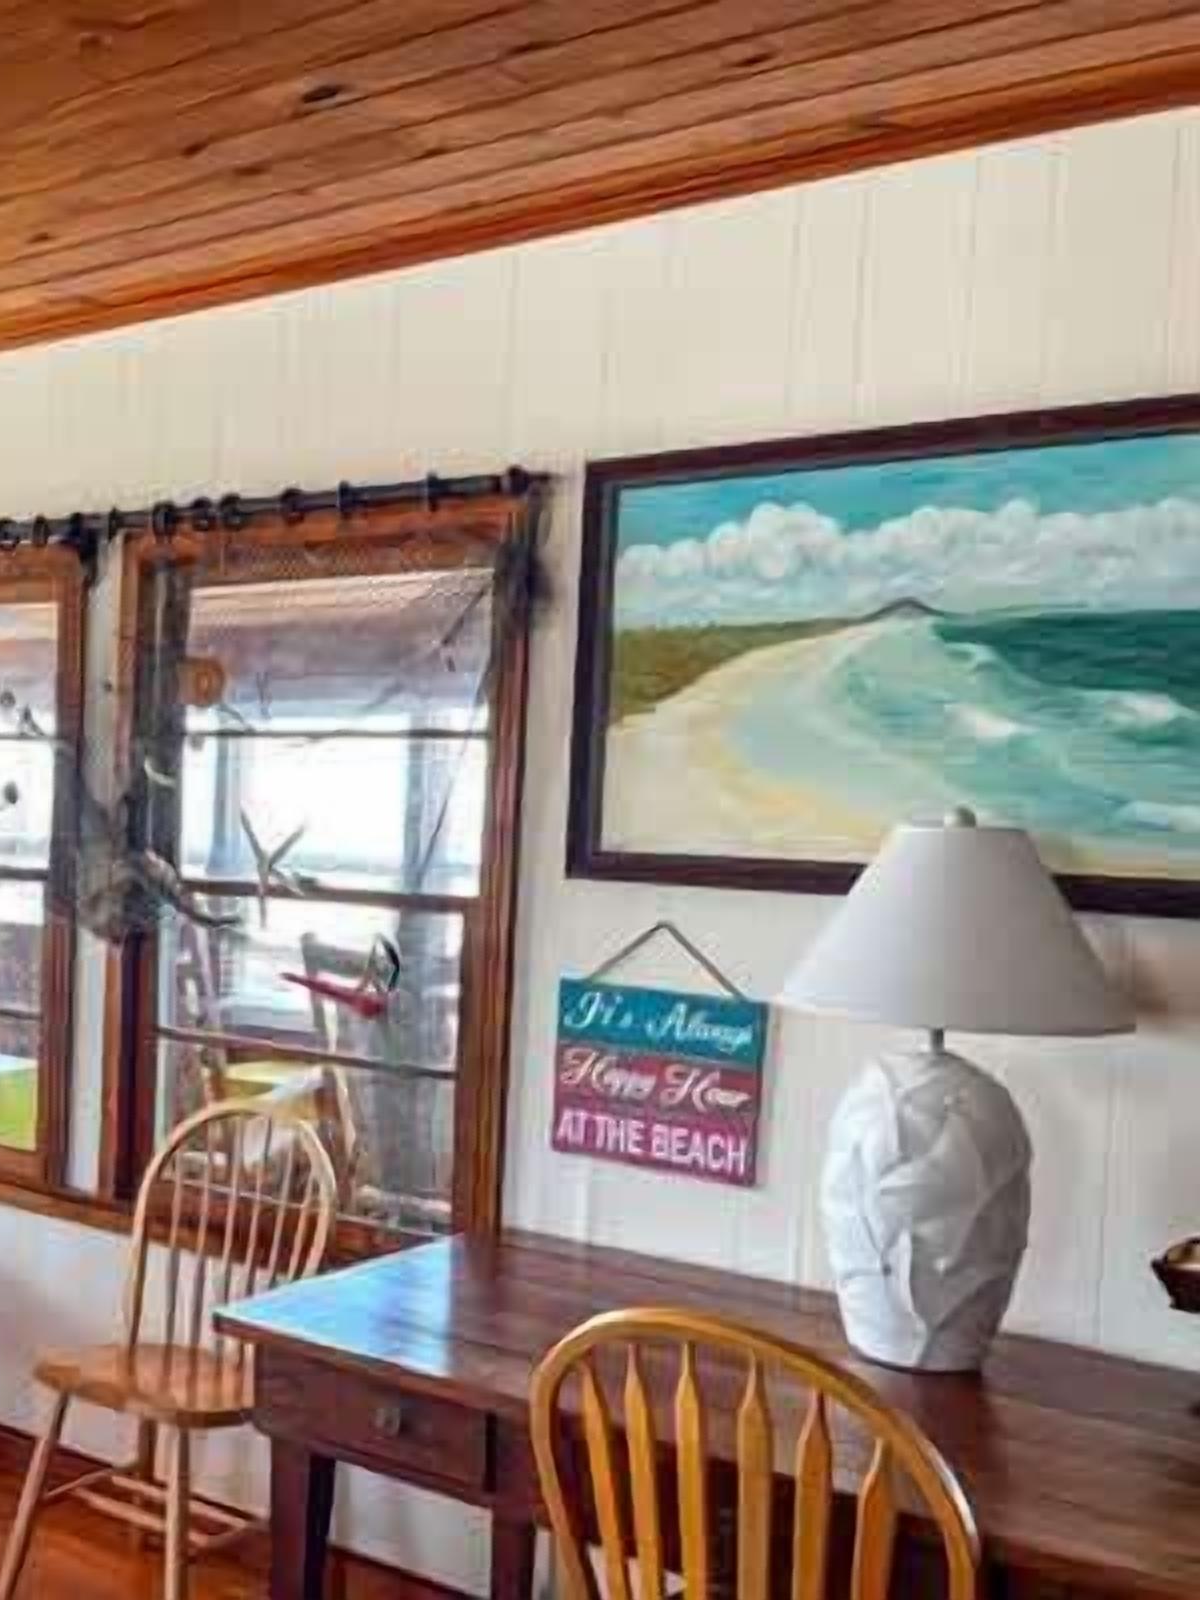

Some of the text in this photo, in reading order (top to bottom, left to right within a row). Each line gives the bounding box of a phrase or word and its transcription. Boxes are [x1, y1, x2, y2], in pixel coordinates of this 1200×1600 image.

[557, 1108, 746, 1176] AT THE BEACH
